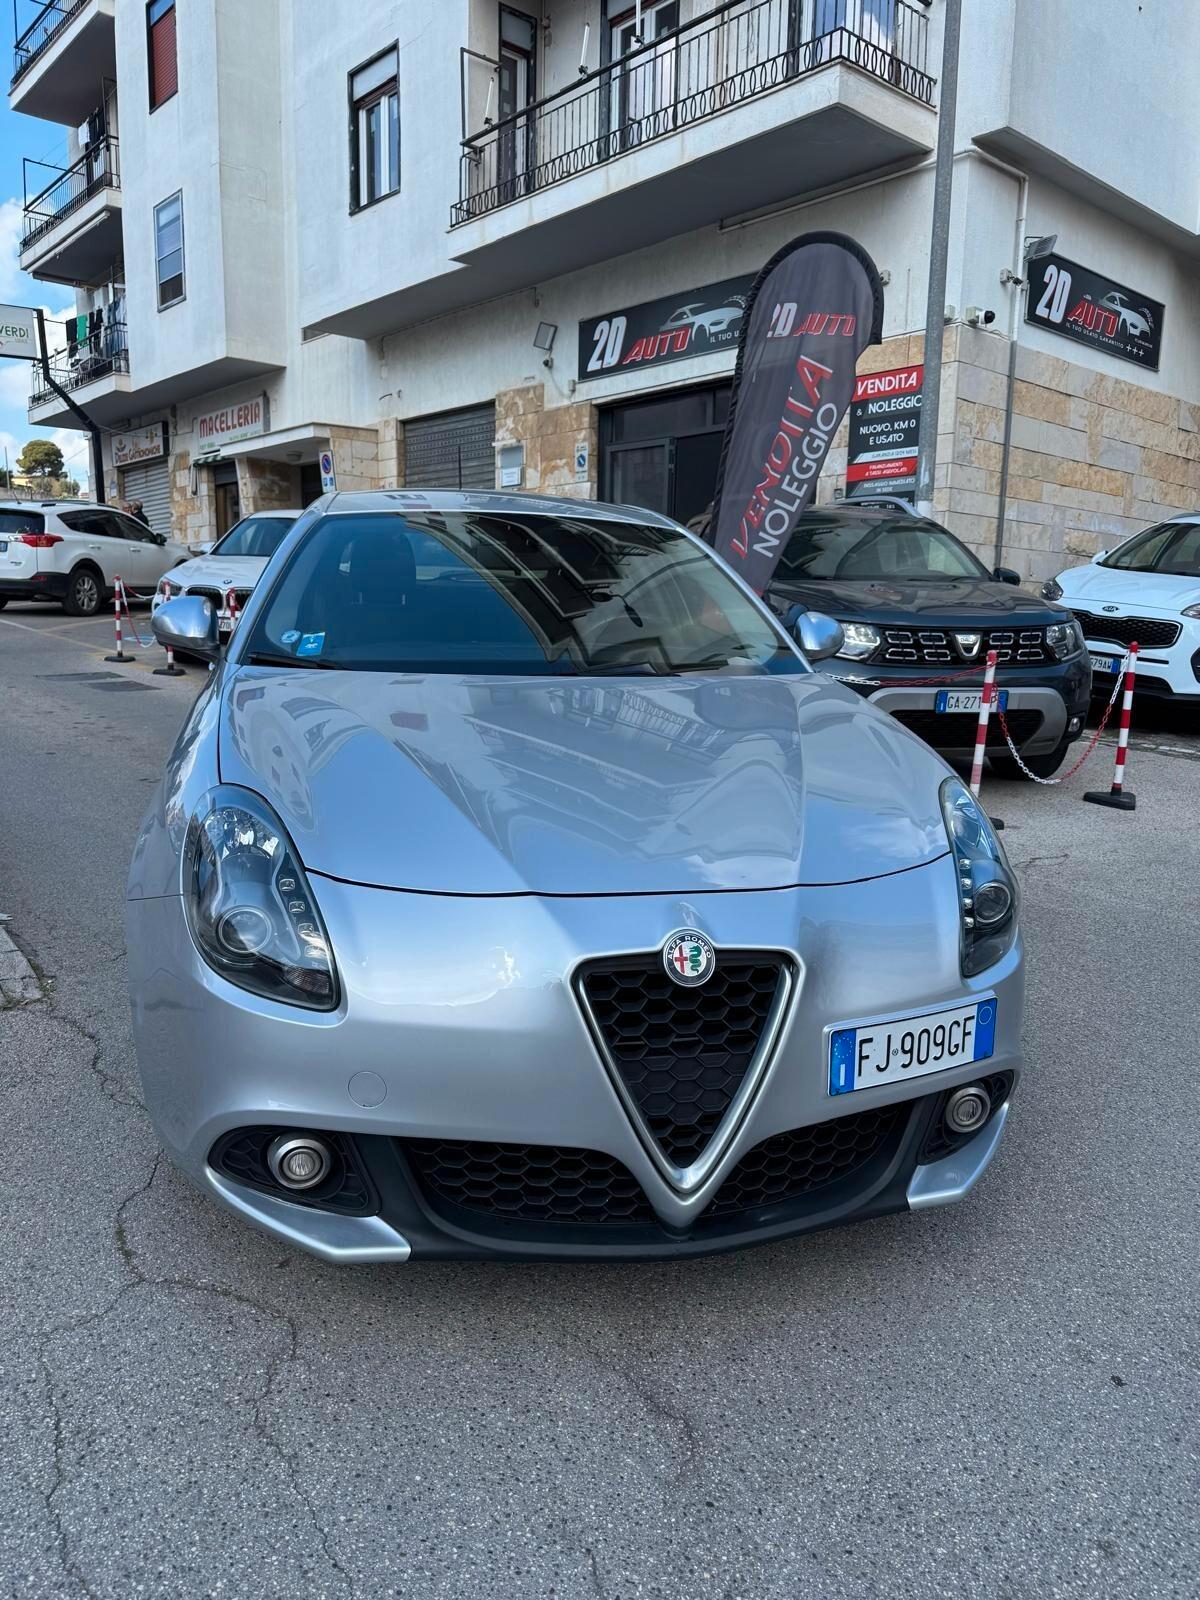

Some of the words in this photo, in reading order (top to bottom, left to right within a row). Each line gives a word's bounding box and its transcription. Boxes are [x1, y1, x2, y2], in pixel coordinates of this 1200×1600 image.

[1035, 264, 1072, 324] 2D
[1067, 297, 1119, 338] AUTO
[586, 315, 627, 372] 2D
[622, 325, 692, 365] AUTO
[718, 332, 732, 342] TUO
[857, 371, 918, 396] VENDITA
[199, 401, 261, 438] MACELLERIA
[856, 408, 863, 416] &
[893, 420, 909, 430] KM
[869, 436, 875, 445] E
[875, 432, 905, 444] USATO
[752, 402, 838, 558] NOLEGGIO
[667, 939, 682, 960] ALFA
[684, 935, 712, 959] ROMEO
